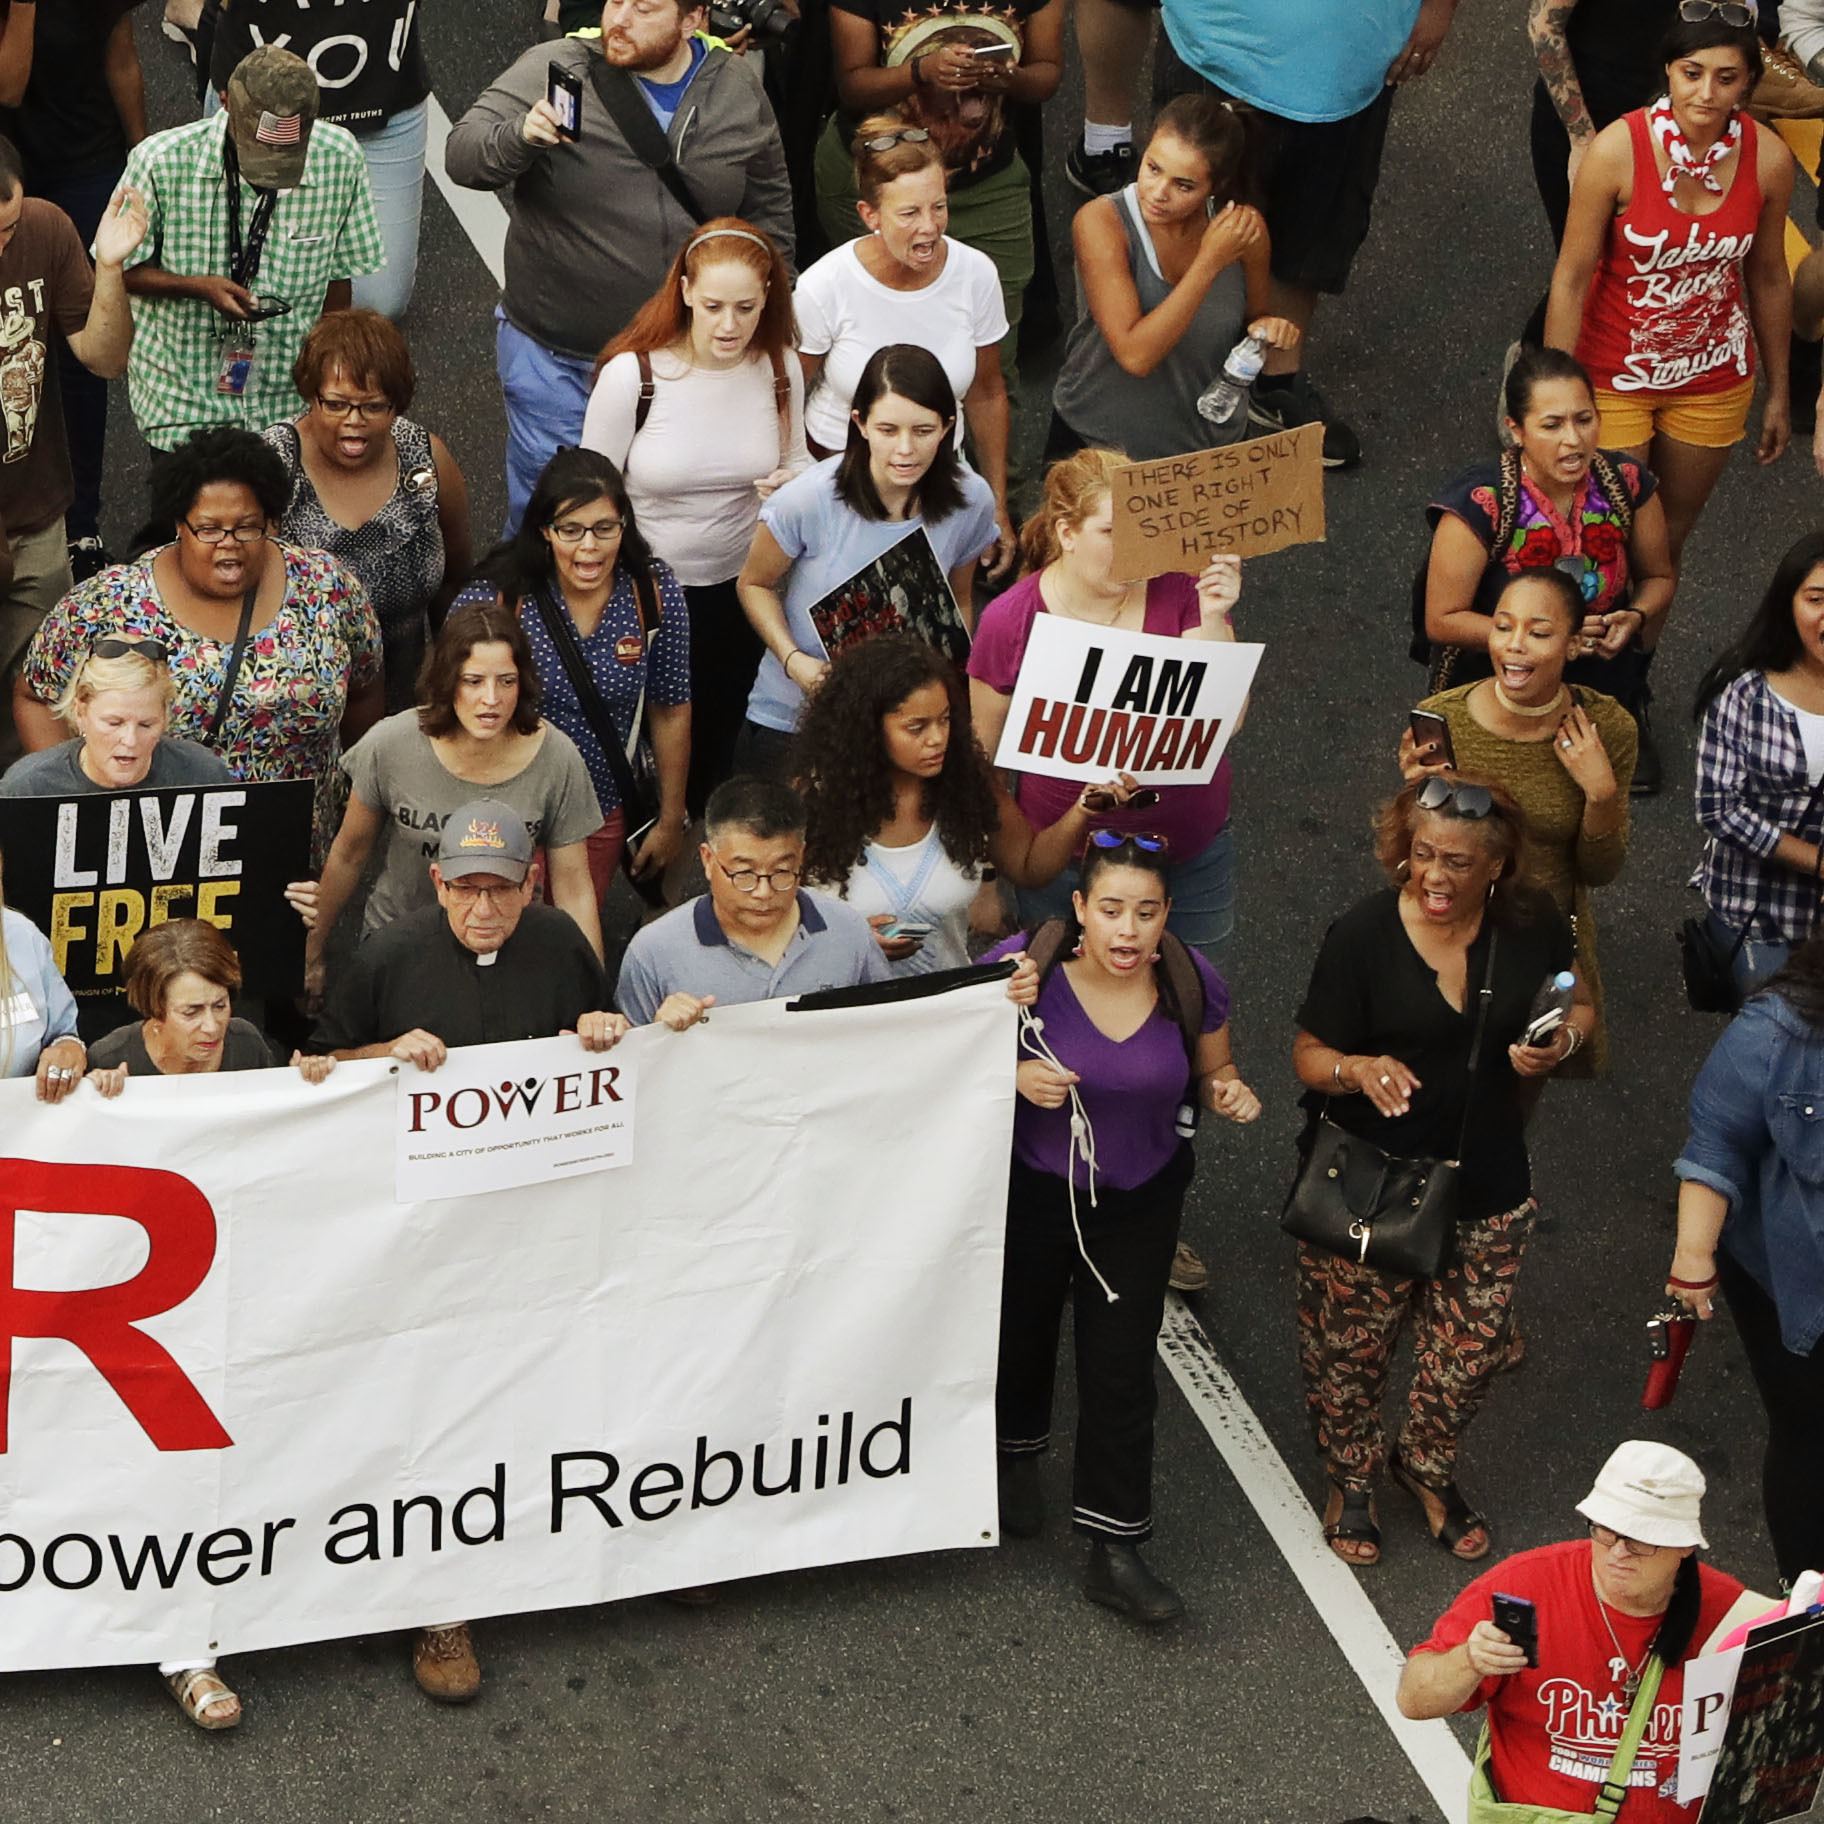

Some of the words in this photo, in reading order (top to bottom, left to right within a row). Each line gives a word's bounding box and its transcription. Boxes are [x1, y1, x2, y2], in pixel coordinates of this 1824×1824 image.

[1622, 221, 1752, 275] Taking
[1121, 457, 1202, 488] THERE
[1213, 449, 1241, 471] IS
[1245, 432, 1305, 466] ONLY
[1125, 487, 1179, 516] ONE
[1192, 464, 1275, 504] RIGHT
[1139, 508, 1211, 539] SIDE
[1221, 496, 1252, 521] OF
[1181, 502, 1306, 557] HISTORY
[1073, 646, 1105, 706] I
[1109, 652, 1209, 719] AM
[1016, 695, 1224, 774] HUMAN
[52, 788, 248, 890] LIVE
[51, 881, 242, 978] FREE
[406, 1066, 625, 1137] POWER
[408, 1149, 446, 1163] BUILDING
[456, 1147, 474, 1159] CITY
[488, 1137, 542, 1155] OPPORTUNITY
[564, 1127, 594, 1142] WORKS
[324, 1463, 507, 1567] and
[550, 1397, 915, 1536] Rebuild
